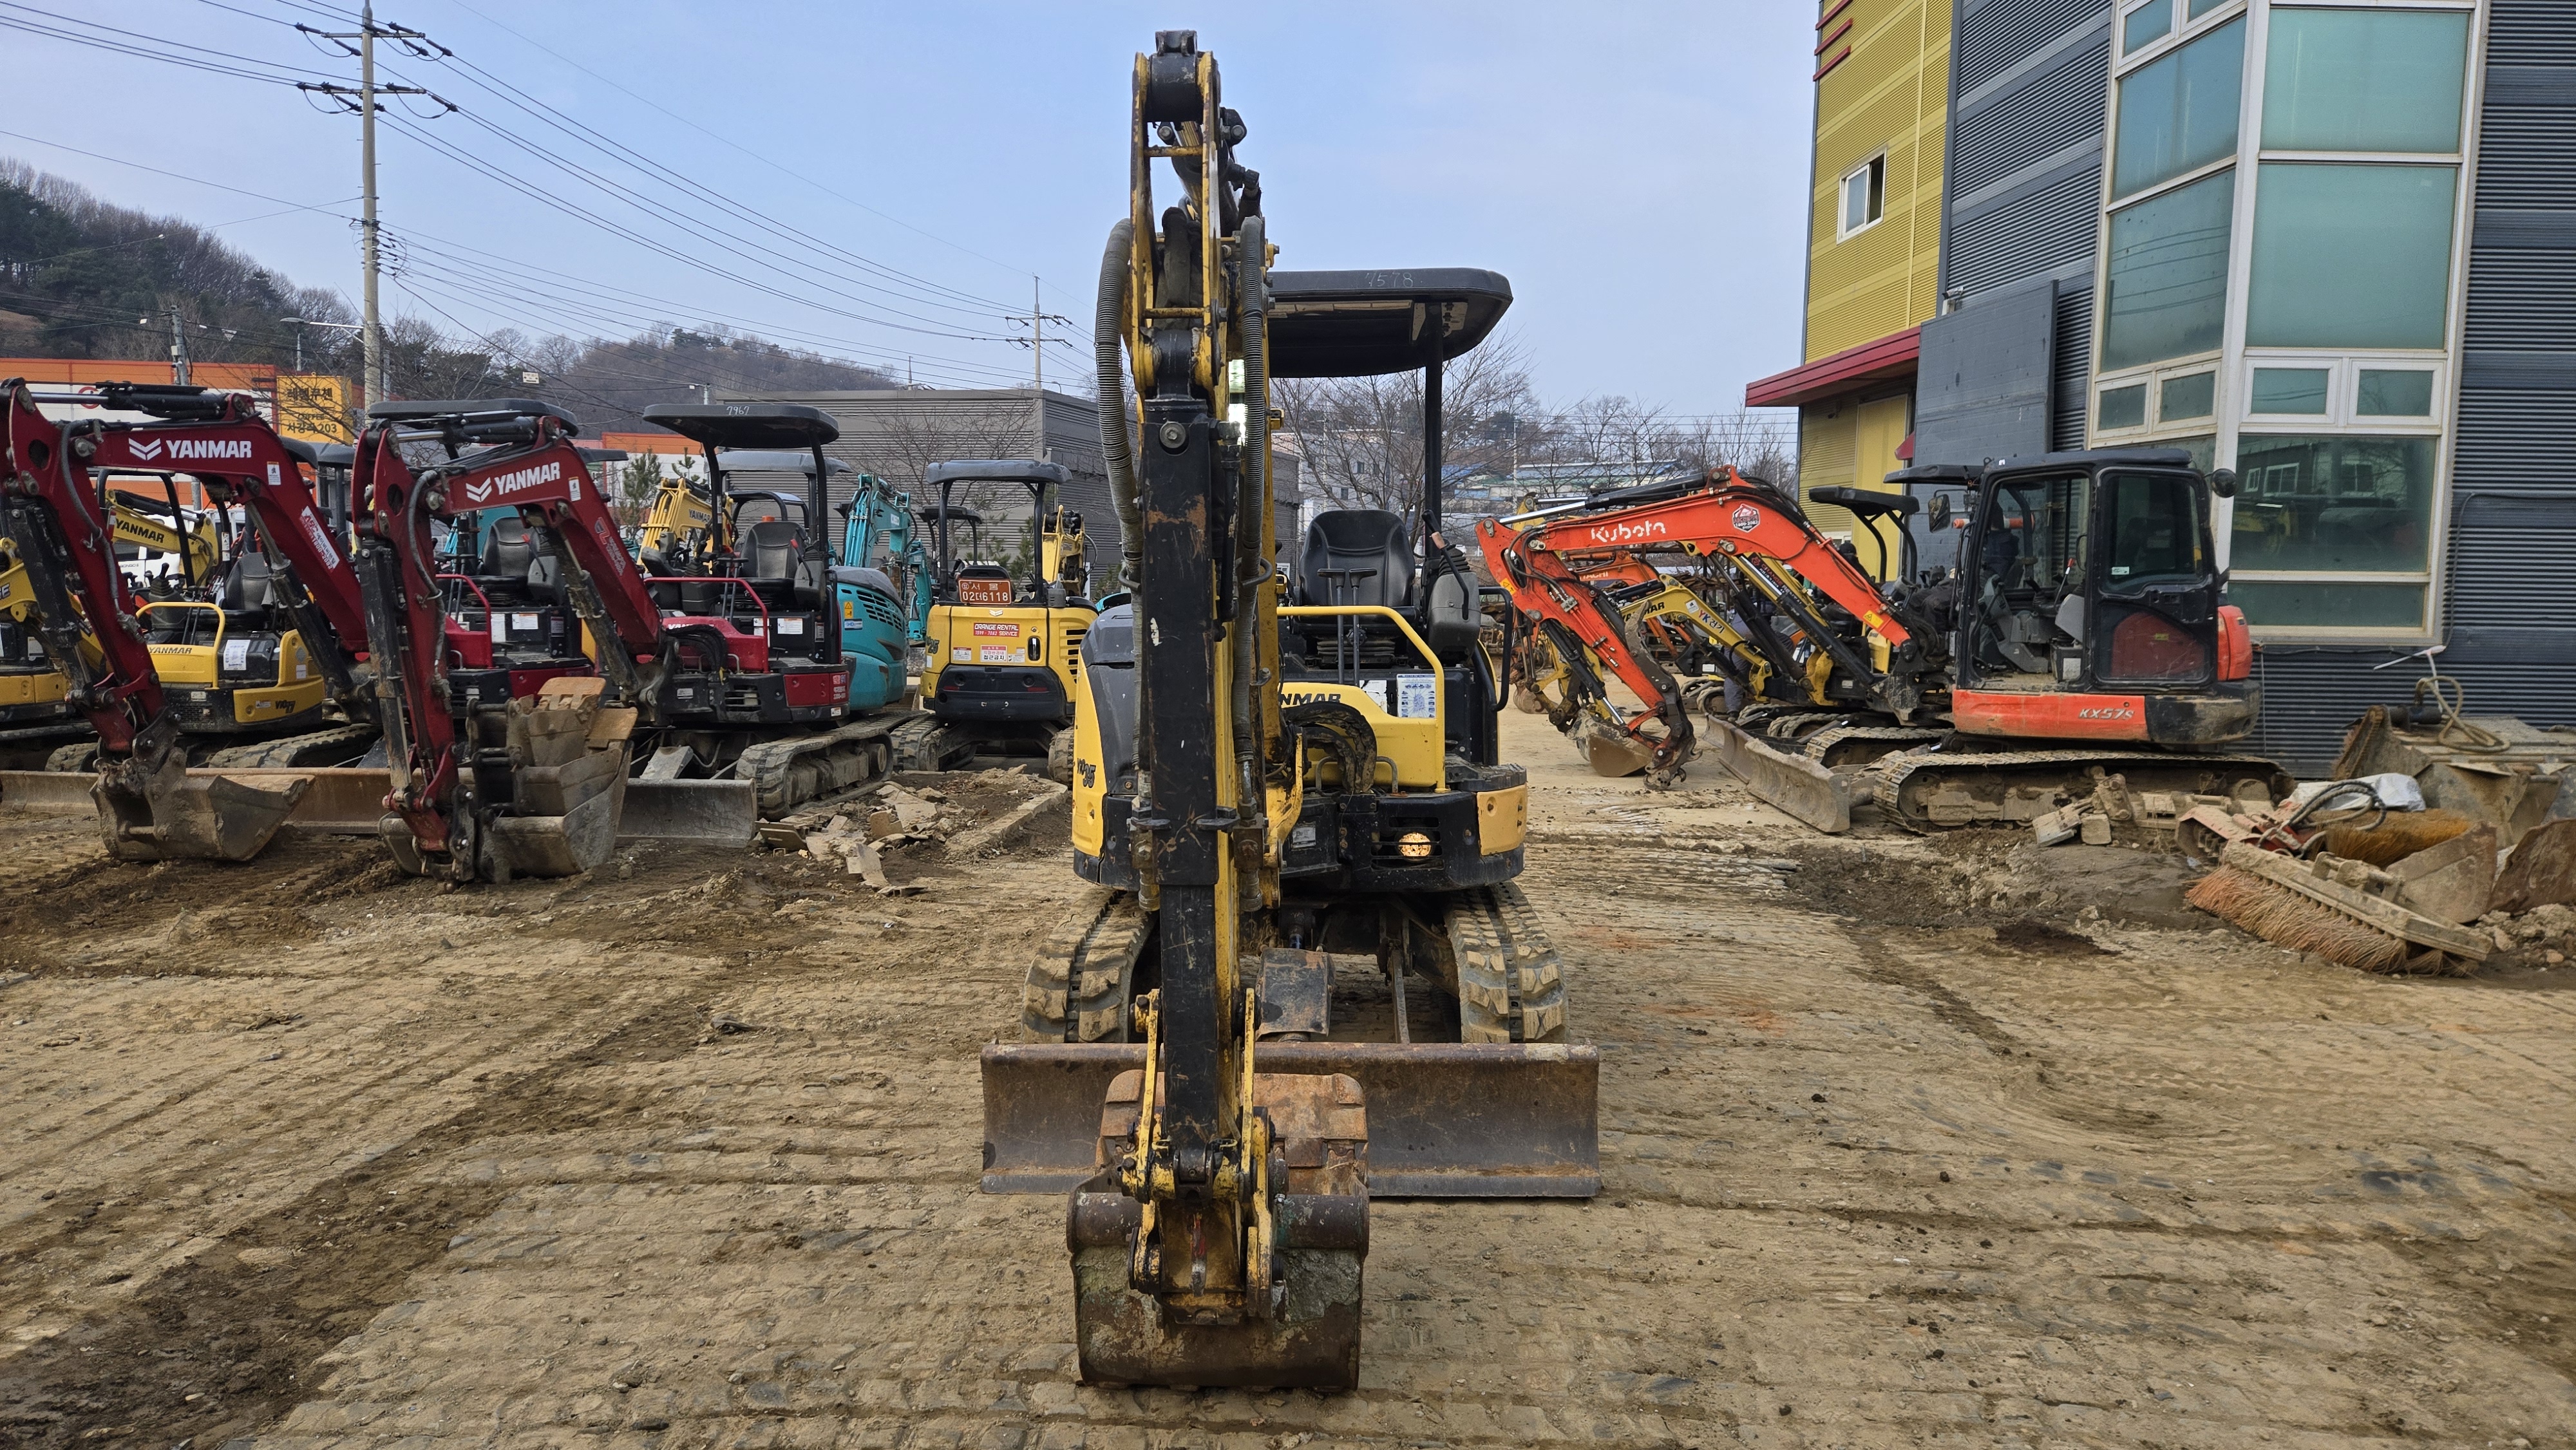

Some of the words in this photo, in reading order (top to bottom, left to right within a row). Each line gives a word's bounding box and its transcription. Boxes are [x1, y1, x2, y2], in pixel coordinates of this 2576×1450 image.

[726, 406, 750, 416] 7967
[317, 423, 337, 433] 203
[166, 440, 252, 458] YANMAR
[494, 462, 560, 495] YANMAR
[115, 518, 164, 543] YANMAR
[1591, 520, 1666, 542] Kubota
[1280, 693, 1341, 706] NMAR
